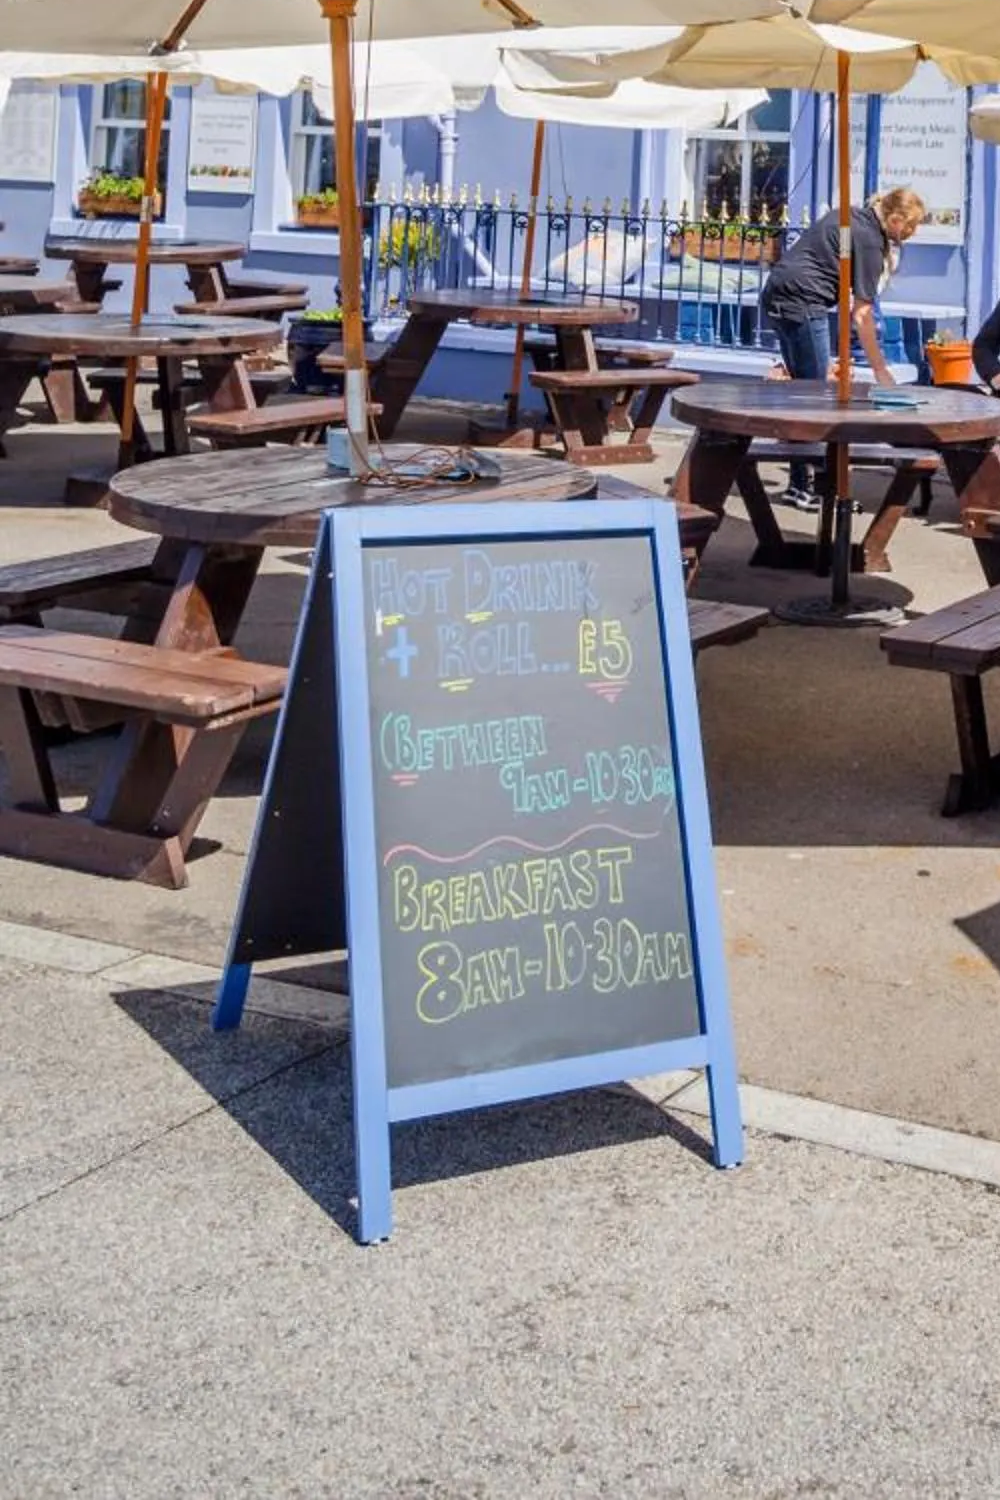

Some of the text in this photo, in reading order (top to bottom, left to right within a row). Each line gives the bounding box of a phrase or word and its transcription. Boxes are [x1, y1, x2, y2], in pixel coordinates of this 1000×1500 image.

[370, 548, 600, 615] HOT DRINK
[578, 618, 634, 680] £5
[394, 846, 633, 932] BREAKFAST
